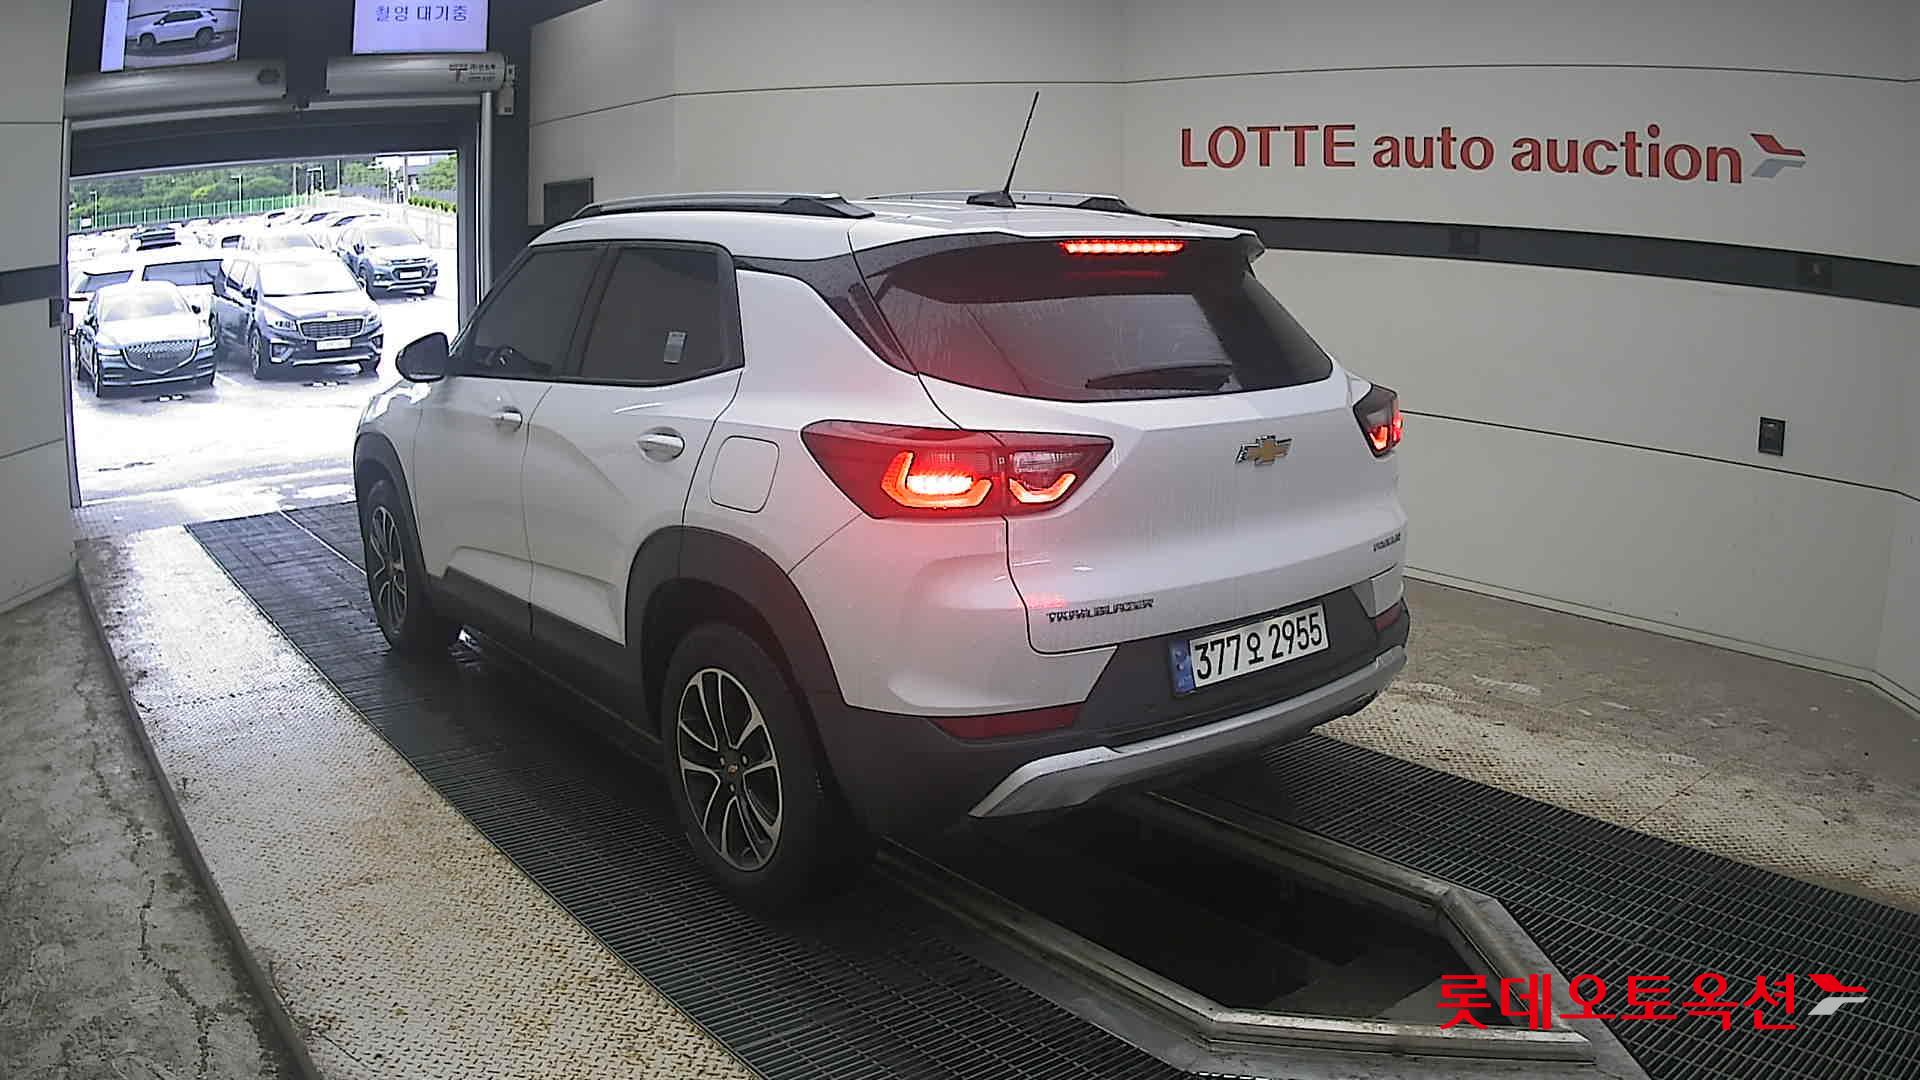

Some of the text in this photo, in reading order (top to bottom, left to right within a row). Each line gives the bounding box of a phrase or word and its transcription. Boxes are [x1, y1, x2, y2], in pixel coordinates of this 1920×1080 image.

[1180, 123, 1743, 184] LOTTE auto auction
[1268, 612, 1323, 660] 2955
